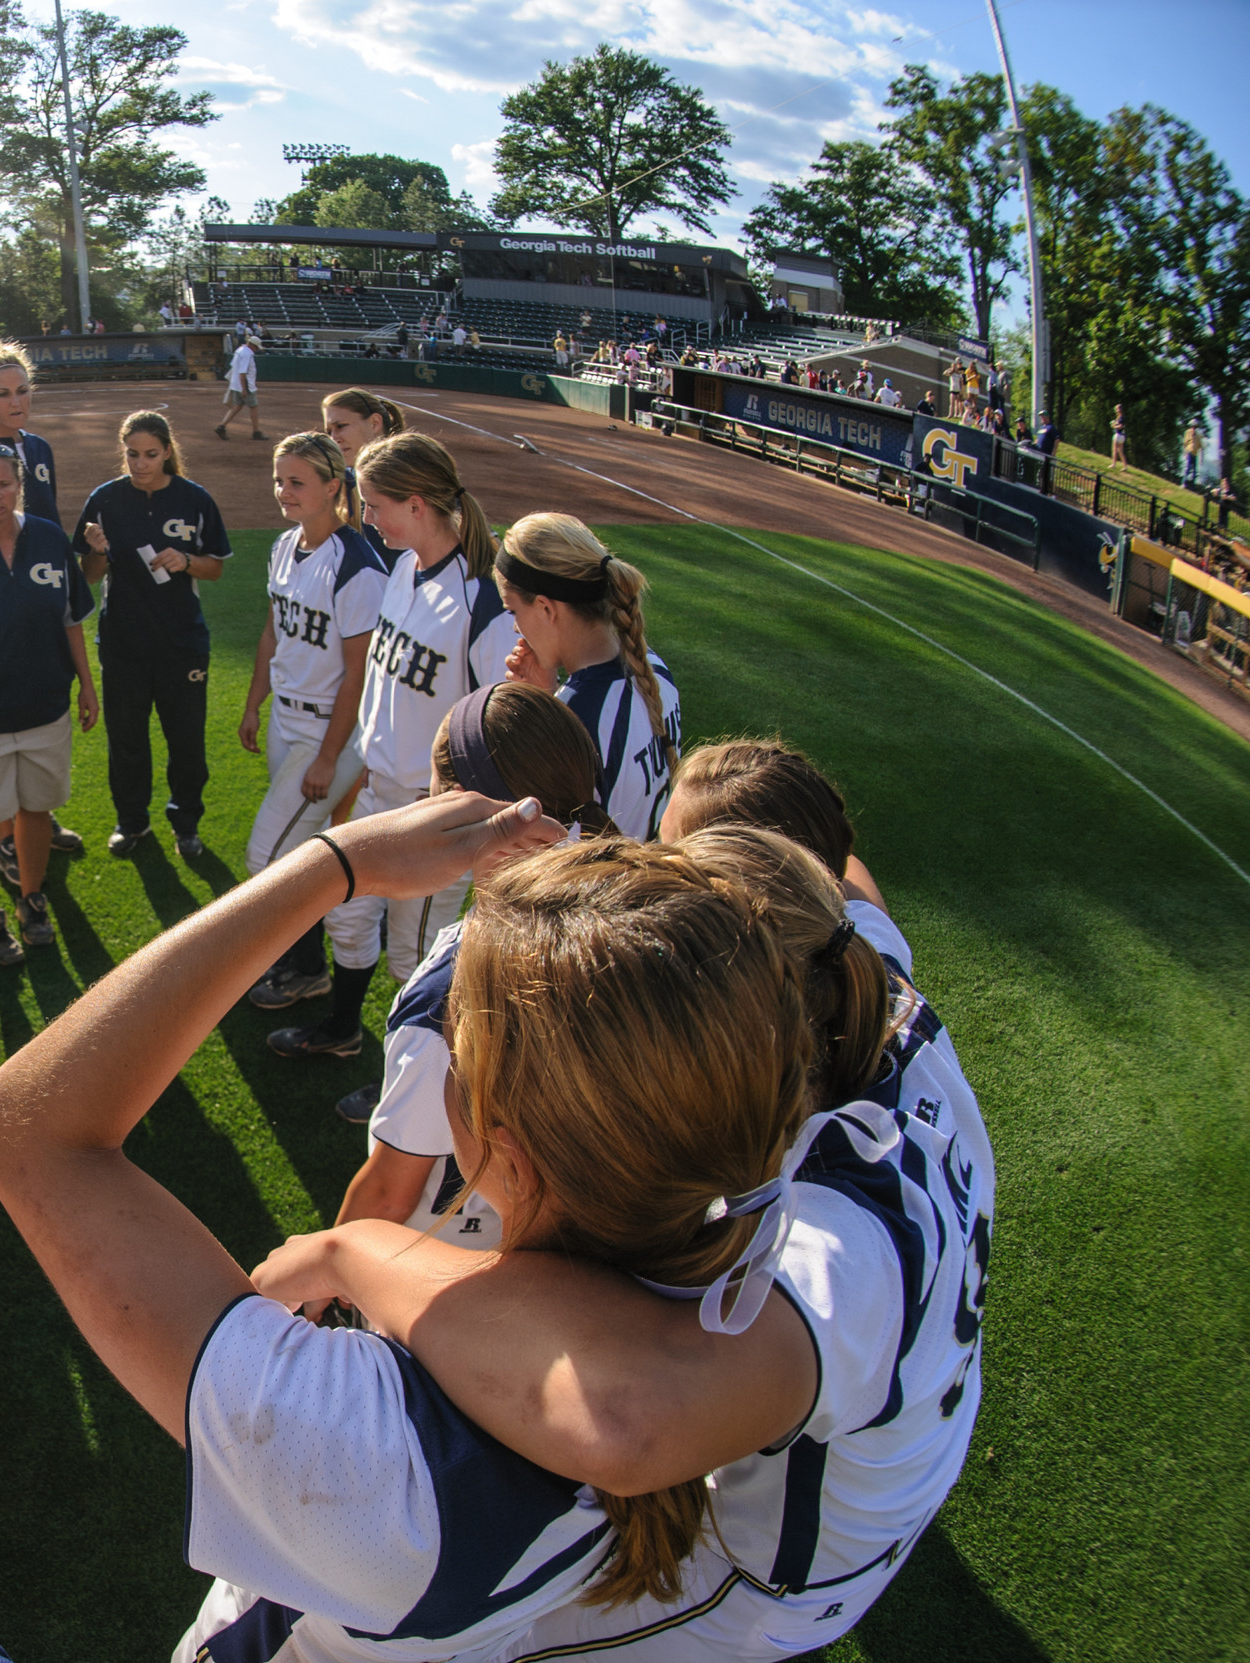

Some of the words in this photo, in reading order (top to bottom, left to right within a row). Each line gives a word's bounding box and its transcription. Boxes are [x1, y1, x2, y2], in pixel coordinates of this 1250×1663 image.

[450, 237, 465, 248] GT
[500, 238, 556, 252] Georgia
[557, 241, 592, 254] Tech
[596, 243, 656, 260] Softball
[59, 345, 108, 360] TECH
[415, 364, 436, 383] GT
[521, 374, 545, 395] GT
[768, 401, 833, 437] GEORGIA
[838, 416, 882, 450] TECH
[922, 428, 979, 495] GT
[163, 519, 196, 541] GT
[29, 562, 64, 588] GT
